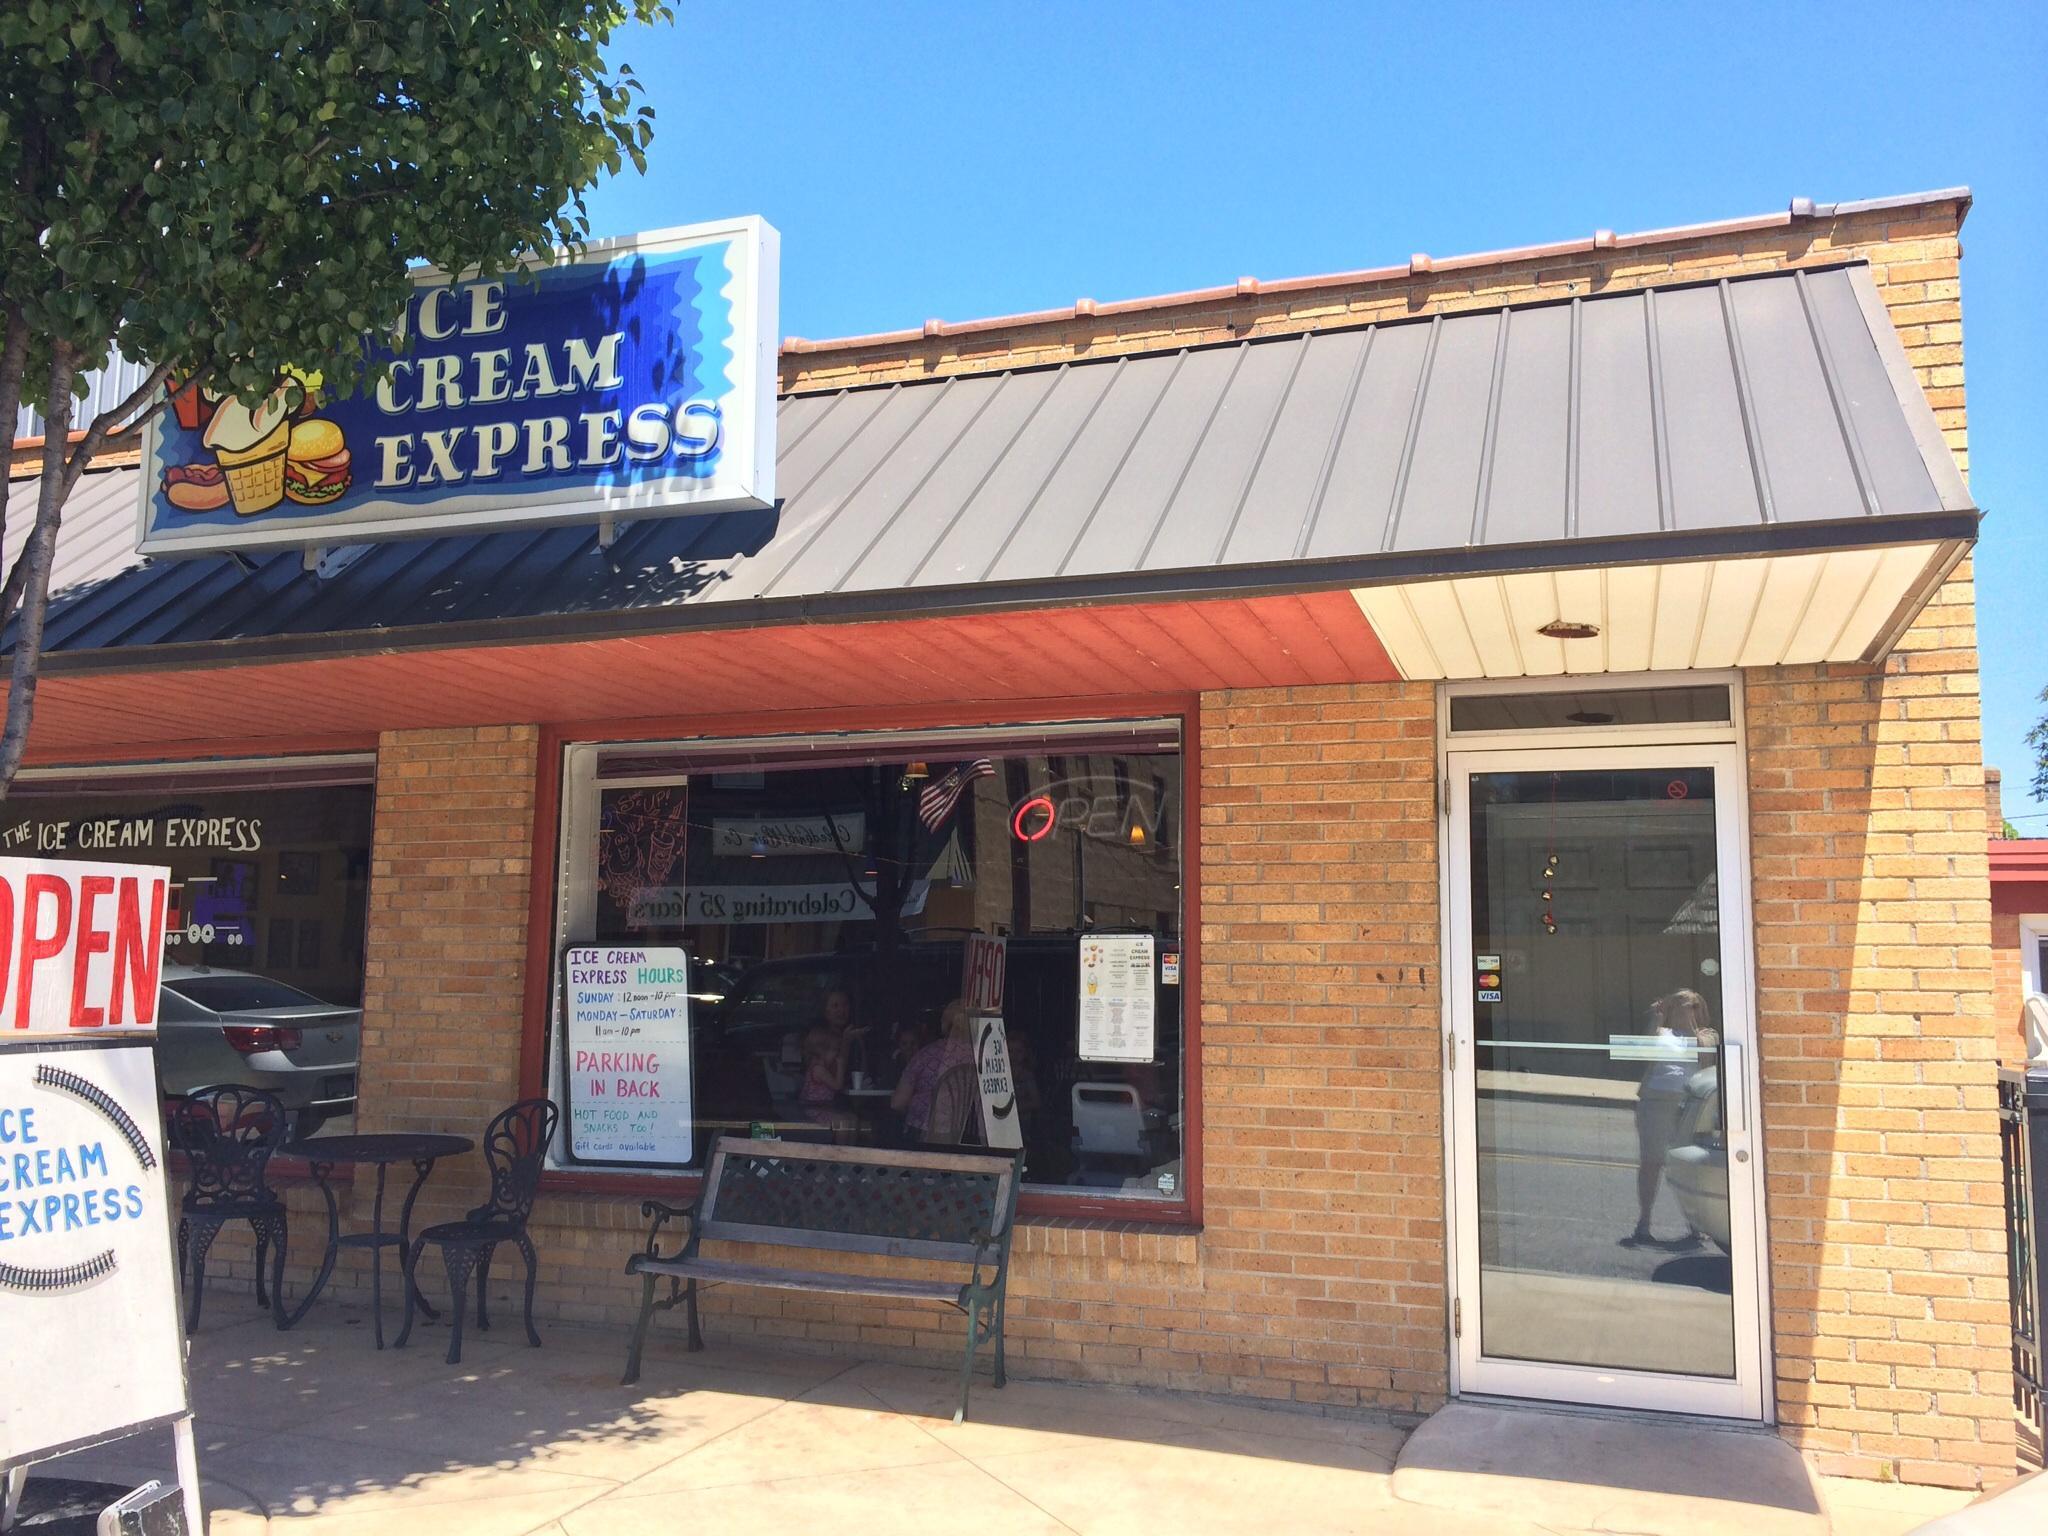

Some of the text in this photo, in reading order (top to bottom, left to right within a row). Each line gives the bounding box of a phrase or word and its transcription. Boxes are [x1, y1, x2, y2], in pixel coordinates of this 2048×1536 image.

[376, 331, 625, 414] CREAM
[373, 399, 721, 489] EXPRESS
[1014, 789, 1166, 842] OPEN
[2, 816, 262, 851] THE ICE CREAM EXPRESS
[571, 950, 647, 965] ICE CREAM
[572, 967, 684, 984] EXPRESS HOURS
[577, 1010, 617, 1022] MONDAY
[576, 1050, 660, 1074] PARKING
[591, 1078, 660, 1098] IN BACK
[574, 1108, 658, 1120] HOT FOOD AND
[583, 1123, 619, 1134] SNACKS
[575, 1141, 657, 1151] Gift cards available
[0, 1185, 143, 1240] EXPRESS
